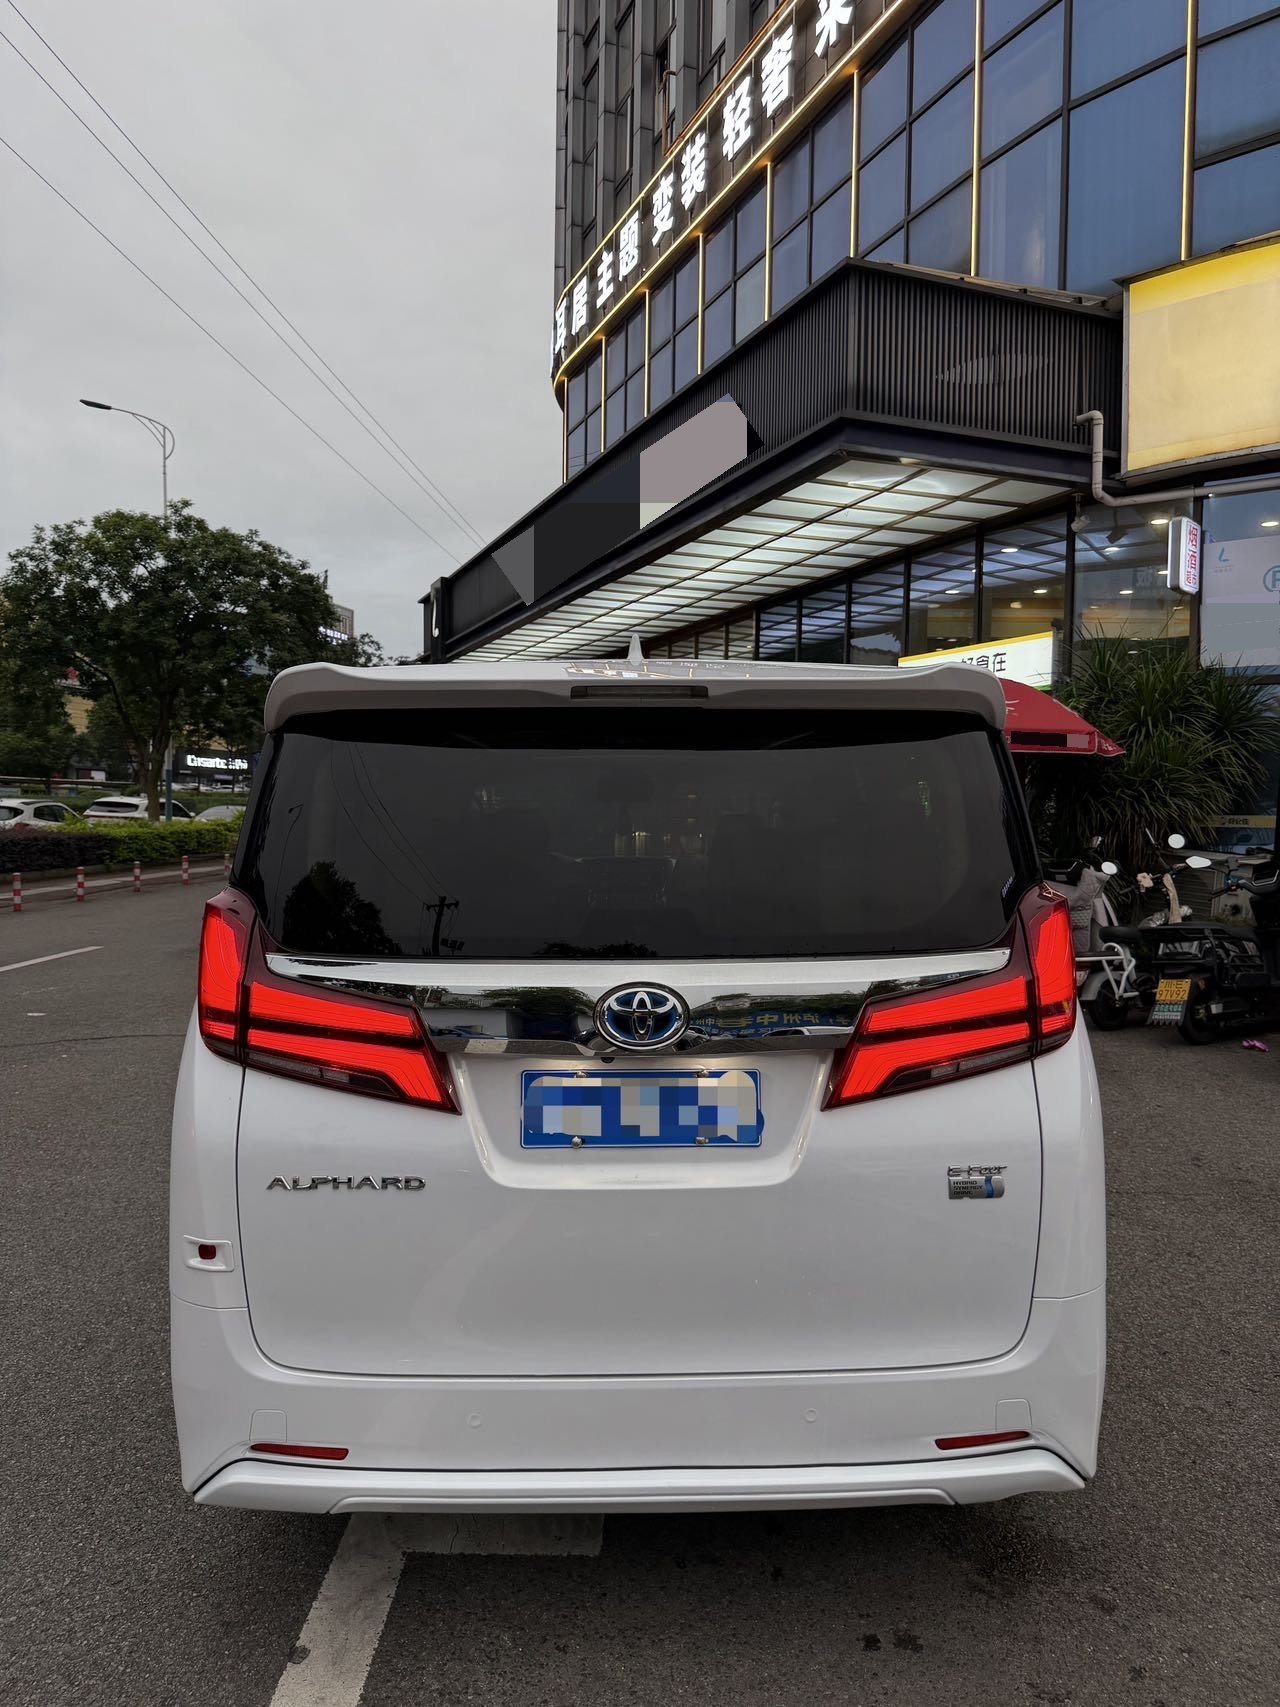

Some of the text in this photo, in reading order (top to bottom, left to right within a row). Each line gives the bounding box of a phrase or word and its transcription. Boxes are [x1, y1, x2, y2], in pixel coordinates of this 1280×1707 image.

[596, 211, 640, 308] 主题
[652, 132, 706, 246] 变装
[722, 24, 796, 161] 轻奢
[266, 1175, 427, 1191] ALPHARD
